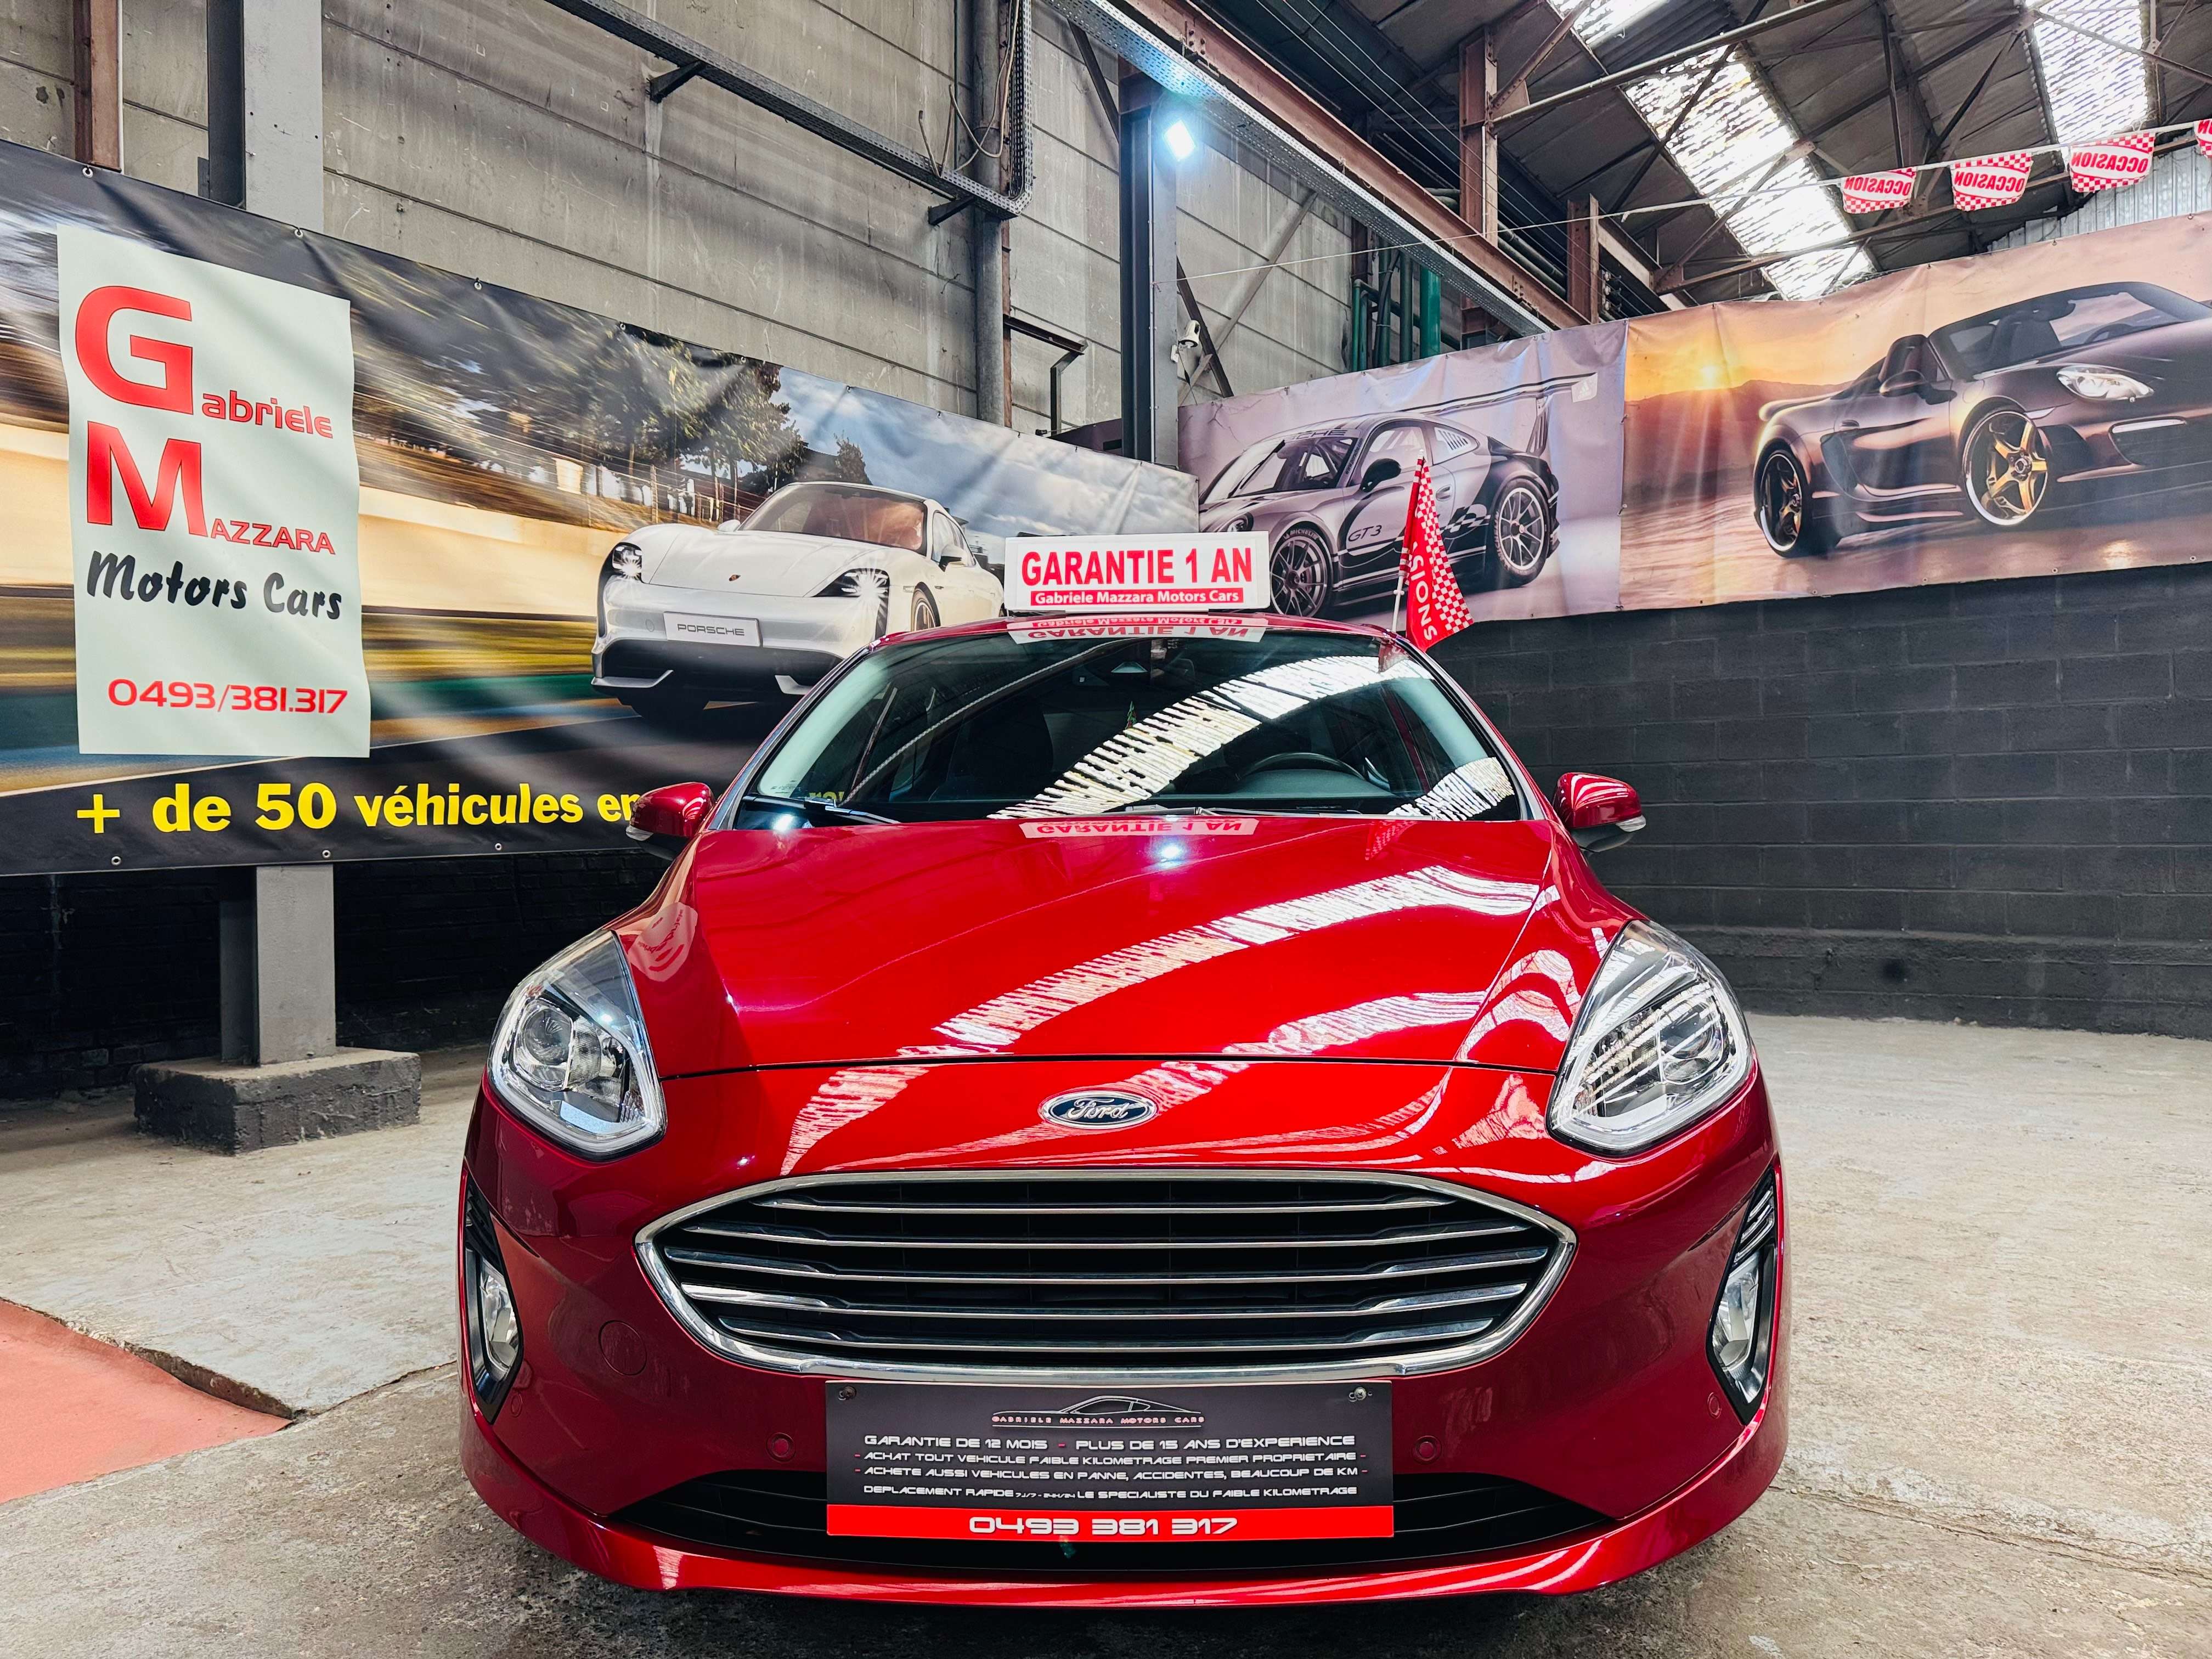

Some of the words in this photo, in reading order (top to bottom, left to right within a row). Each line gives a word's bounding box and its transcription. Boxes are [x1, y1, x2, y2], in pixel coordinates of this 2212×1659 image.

[1021, 549, 1175, 586] GARANTIE
[1185, 548, 1198, 584] 1
[1211, 547, 1252, 583] AN
[87, 550, 247, 610] Motors
[266, 572, 342, 620] Cars
[1035, 590, 1094, 605] Gabriele
[1097, 589, 1154, 604] Mazzara
[1157, 589, 1206, 602] Motors
[1209, 587, 1239, 602] Cars
[678, 624, 744, 636] PORSCHE
[108, 678, 348, 714] 0493/381.317
[152, 783, 231, 833] de
[255, 782, 337, 830] 50
[354, 783, 583, 827] véhicules
[1068, 1098, 1130, 1119] Ford
[864, 1435, 951, 1447] GARANTIE
[956, 1438, 980, 1448] DE
[985, 1438, 1001, 1448] 12
[1006, 1439, 1048, 1449] MOIS
[1076, 1440, 1125, 1450] PLUS
[1129, 1440, 1154, 1450] DE
[1159, 1440, 1178, 1449] 15
[1183, 1439, 1221, 1449] ANS
[1226, 1435, 1355, 1448] D'EXPERIENCE
[864, 1452, 911, 1460] ACHAT
[915, 1453, 954, 1462] TOUT
[957, 1454, 1026, 1464] VEHICULE
[1029, 1456, 1079, 1465] FAIBLE
[1082, 1457, 1182, 1465] KILOMETRAGE
[1186, 1455, 1249, 1464] PREMIER
[1252, 1452, 1356, 1463] PROPRIETAIRE
[864, 1466, 922, 1476] ACHETE
[925, 1469, 968, 1477] AUSSI
[971, 1470, 1050, 1479] VEHICULES
[1053, 1471, 1074, 1480] EN
[1231, 1468, 1310, 1478] BEAUCOUP
[1313, 1468, 1334, 1476] DE
[1337, 1467, 1358, 1476] KM
[864, 1485, 962, 1496] DEPLACEMENT
[966, 1488, 1014, 1497] RAPIDE
[1077, 1491, 1094, 1499] LE
[1098, 1491, 1187, 1499] SPECIALISTE
[1212, 1489, 1260, 1498] FAIBLE
[1263, 1487, 1357, 1497] KILOMETRAGE
[969, 1517, 1079, 1534] 0493
[1092, 1519, 1159, 1535] 381
[1171, 1517, 1238, 1534] 317
